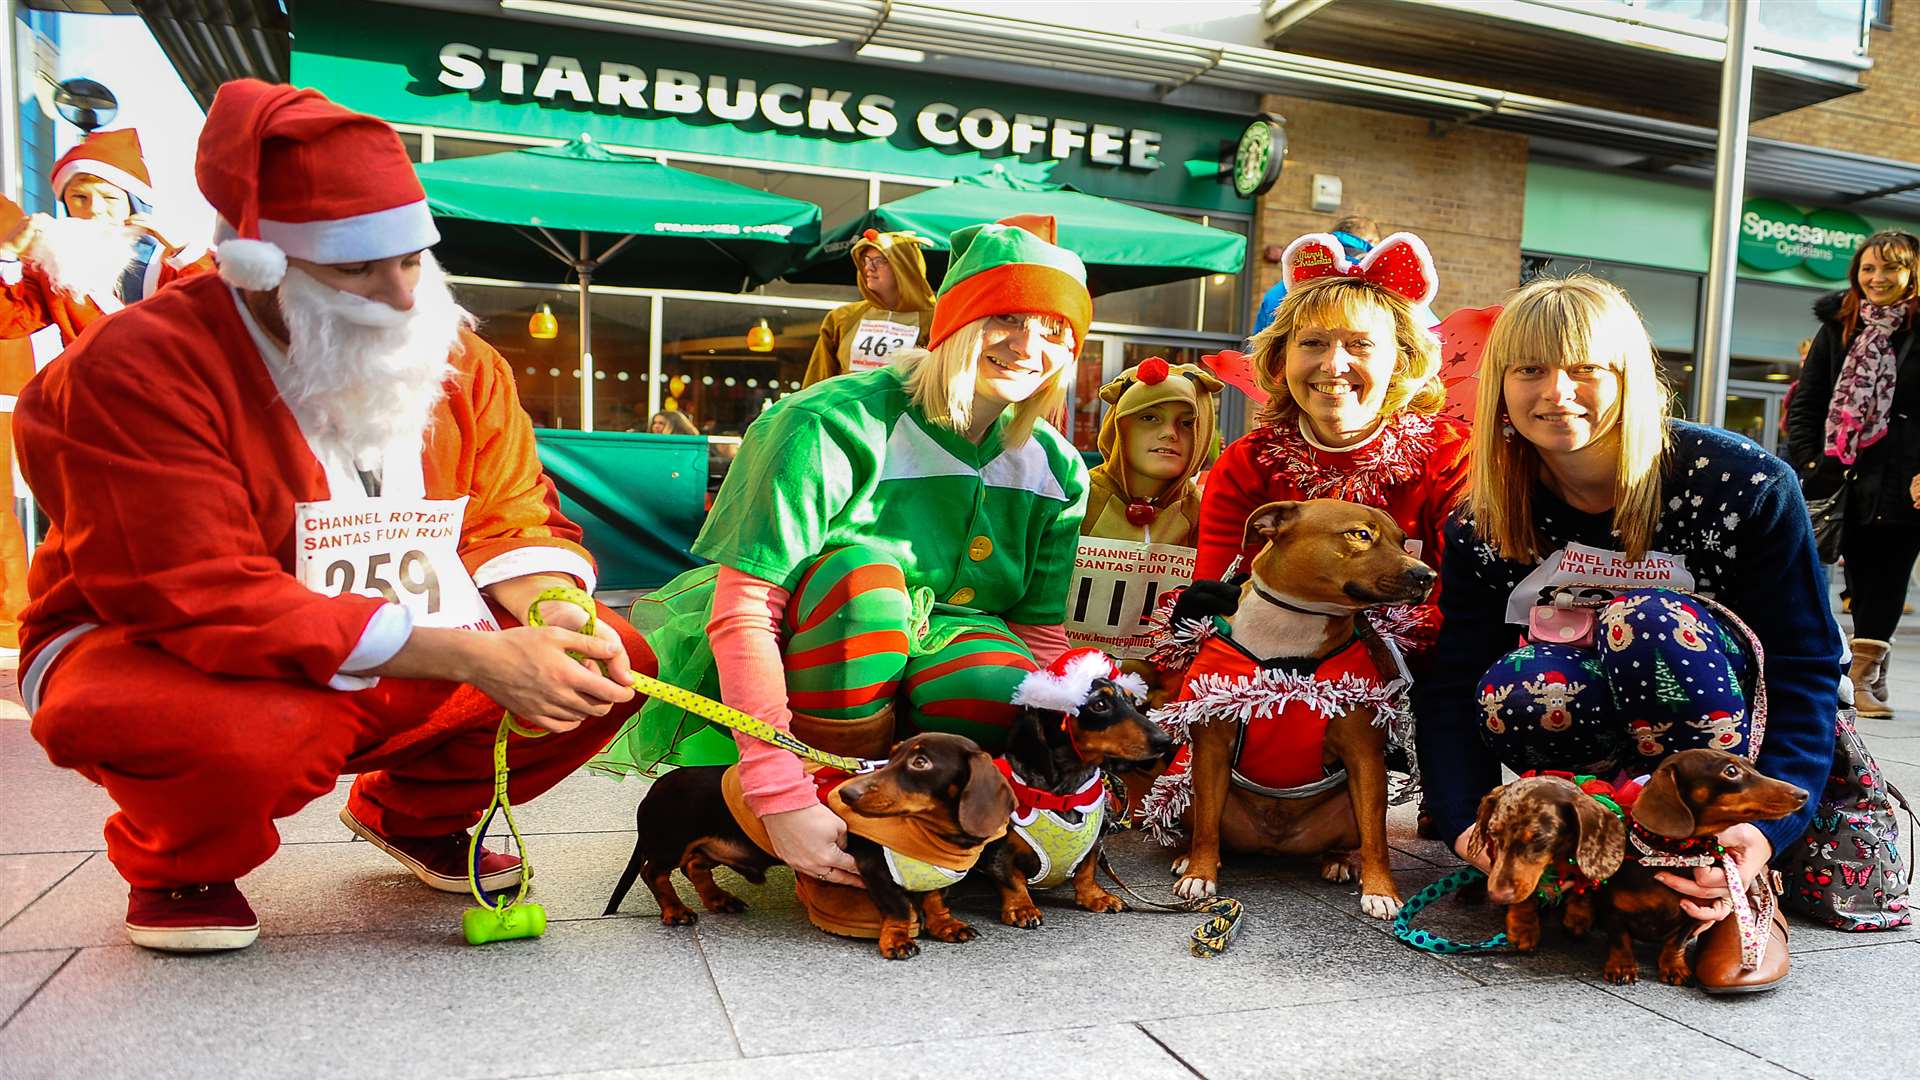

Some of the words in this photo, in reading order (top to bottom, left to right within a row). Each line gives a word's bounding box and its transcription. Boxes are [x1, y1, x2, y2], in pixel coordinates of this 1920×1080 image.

[438, 43, 898, 137] STARBUCKS
[917, 102, 1162, 169] COFFEE
[1743, 212, 1867, 249] Specsavers
[1776, 240, 1833, 260] Opticians
[304, 512, 382, 532] CHANNEL
[389, 511, 454, 523] ROTAR
[304, 530, 370, 551] SANTAS
[376, 528, 410, 542] FUN
[416, 526, 454, 538] RUN
[1077, 545, 1145, 562] CHANNEL
[1150, 552, 1195, 568] ROTAR
[1563, 549, 1605, 567] NNEL
[1075, 558, 1133, 573] SANTAS
[1138, 564, 1167, 575] FUN
[1171, 567, 1191, 579] RU
[1557, 562, 1586, 575] NTA
[1592, 567, 1628, 579] FUN
[1634, 570, 1671, 581] RUN
[325, 549, 440, 614] 259
